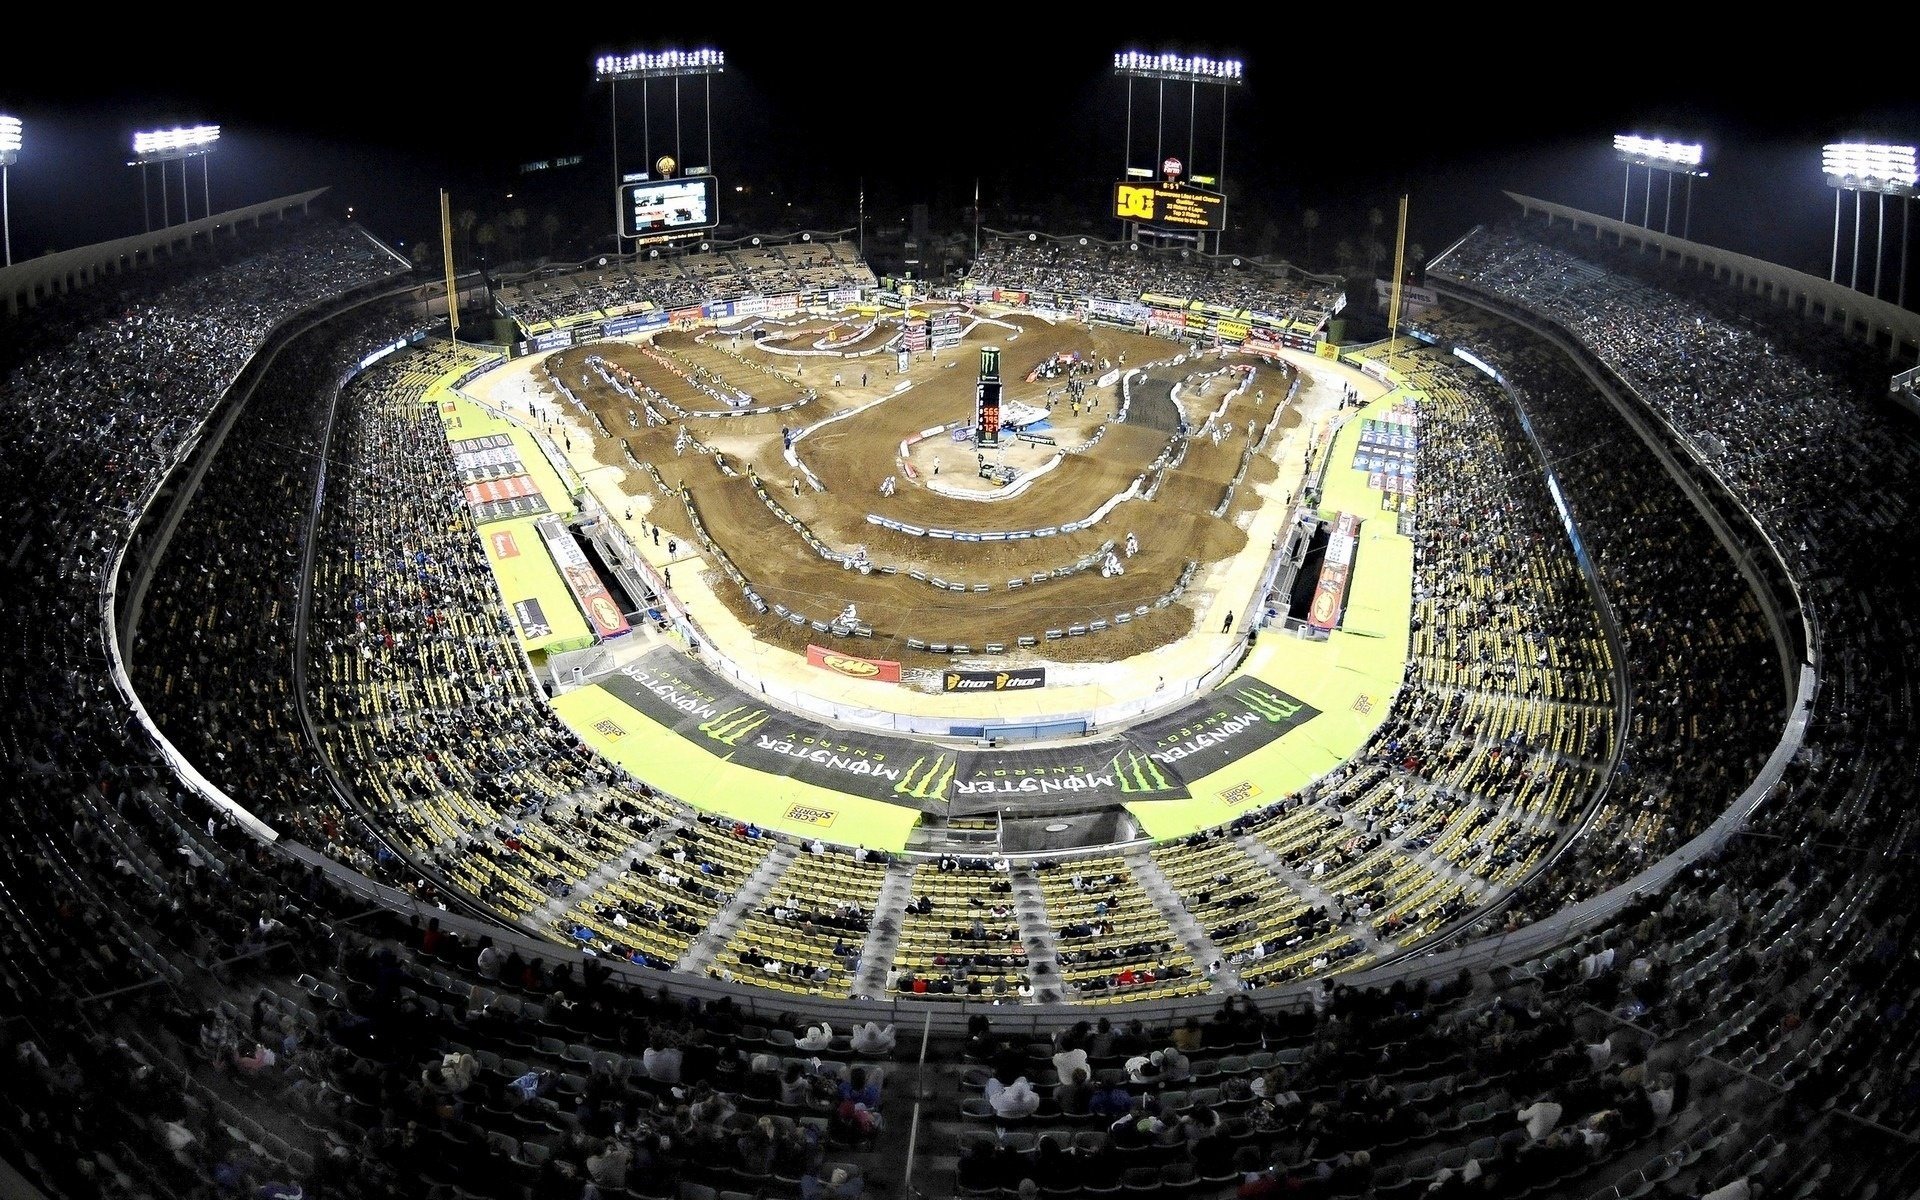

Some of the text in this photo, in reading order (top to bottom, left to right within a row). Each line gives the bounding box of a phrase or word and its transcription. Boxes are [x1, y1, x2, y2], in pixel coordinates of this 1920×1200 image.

[520, 161, 549, 173] THINK
[1117, 186, 1154, 219] DC
[1218, 328, 1245, 336] DUNLO
[984, 408, 999, 416] 565
[984, 416, 998, 424] 795
[829, 656, 879, 674] FMF
[621, 664, 716, 719] MONSTER
[650, 667, 715, 703] ENERGY
[957, 677, 1041, 688] thor thor
[1150, 711, 1261, 763] MONSTER
[1156, 710, 1228, 748] ENERGY
[786, 733, 886, 761] ENERGY
[757, 734, 900, 781] MONSTER
[975, 766, 1085, 777] ENERGY
[953, 773, 1115, 794] MONSTER
[788, 811, 809, 820] CBS
[792, 807, 834, 819] SPORTS
